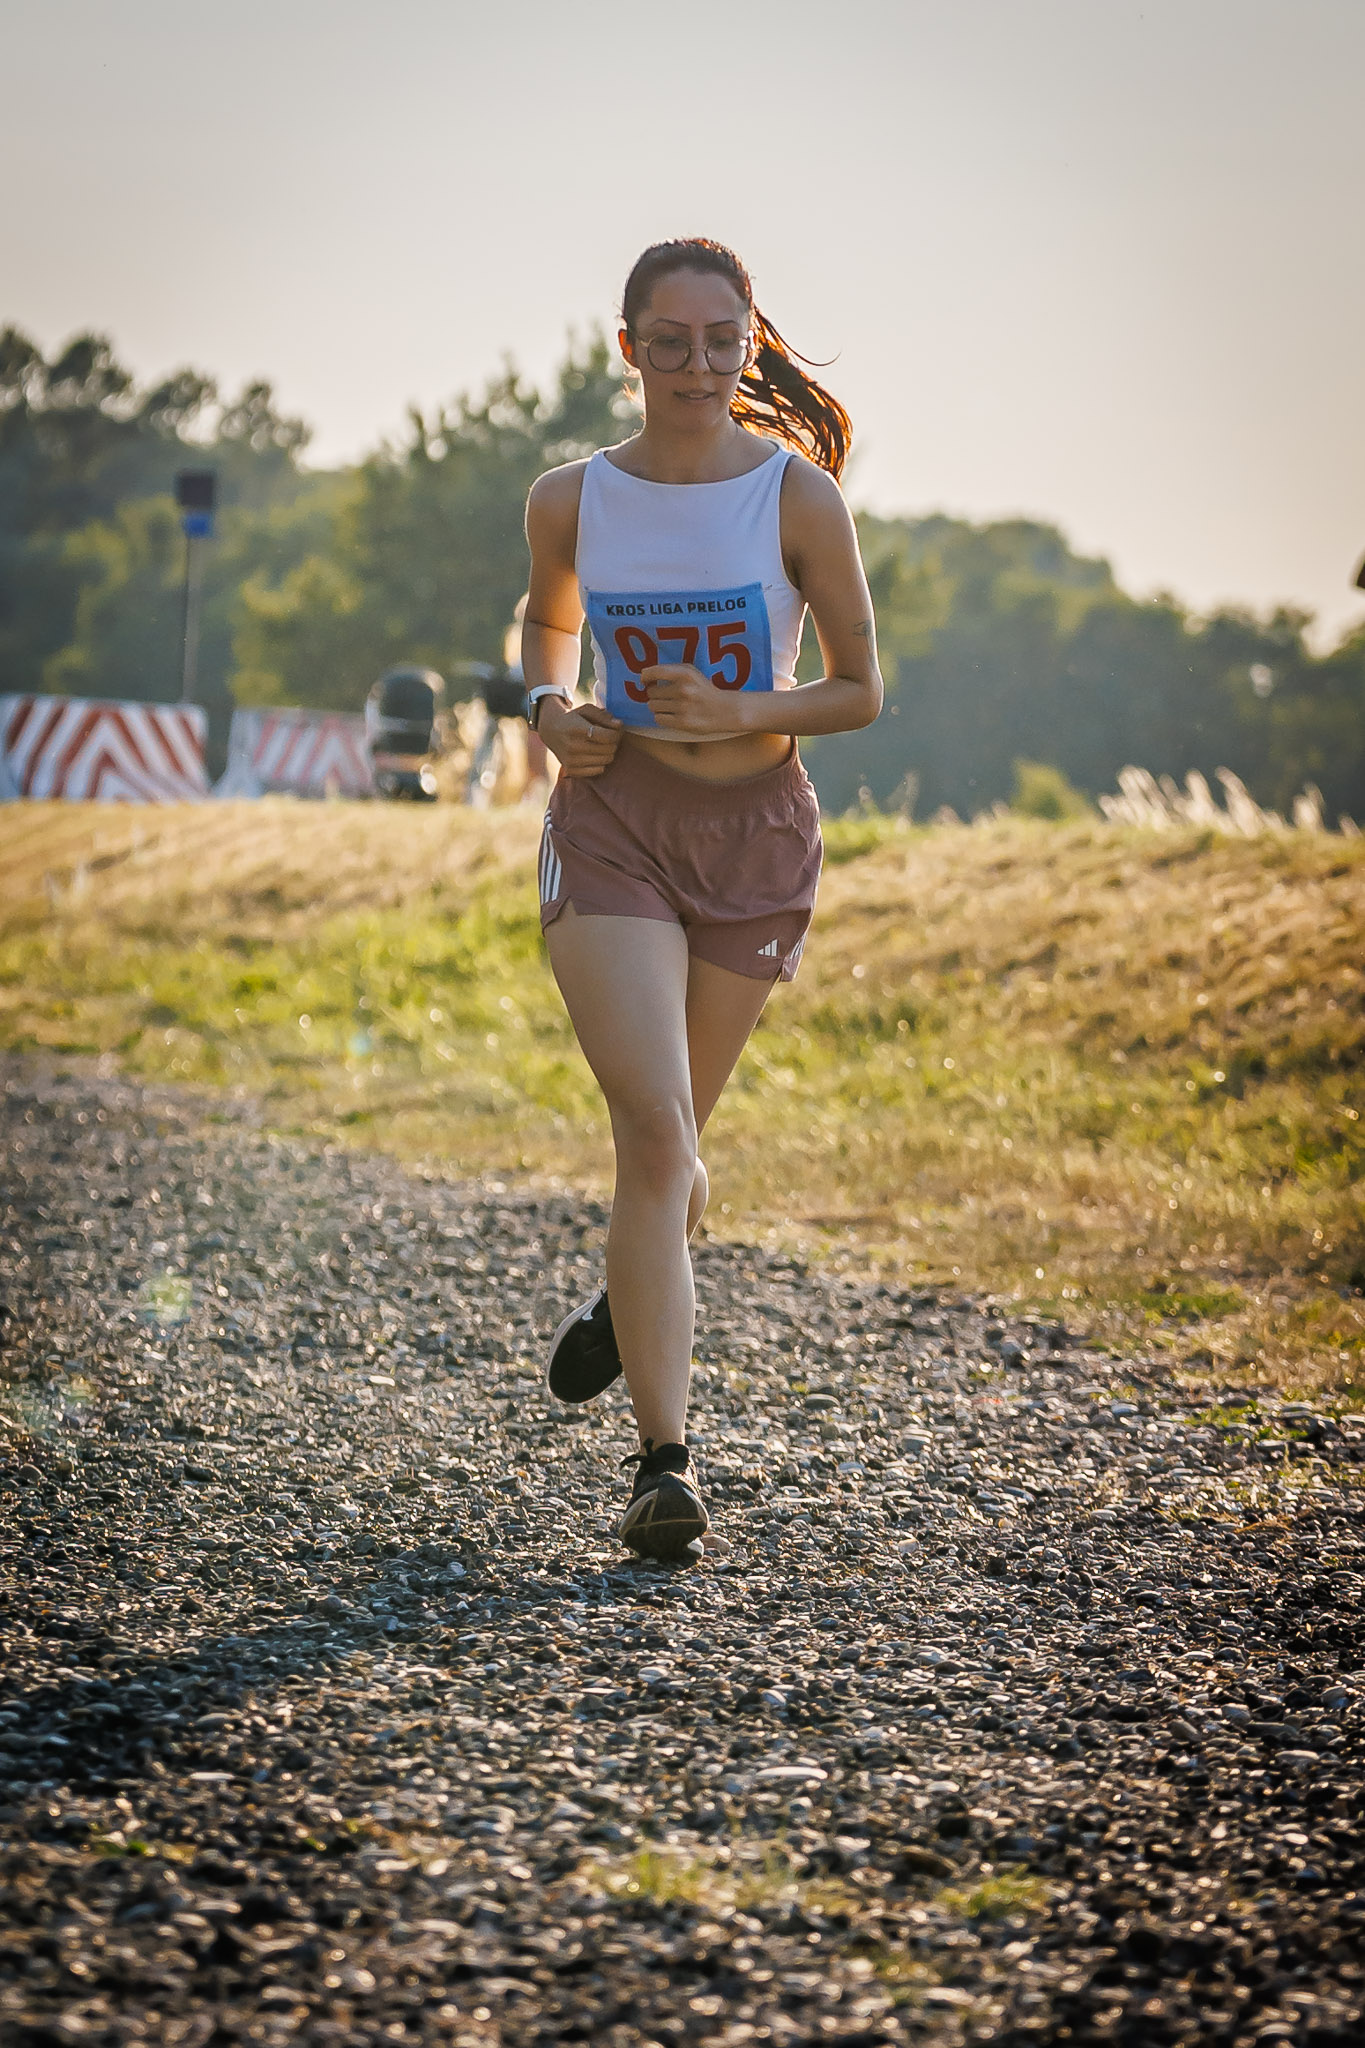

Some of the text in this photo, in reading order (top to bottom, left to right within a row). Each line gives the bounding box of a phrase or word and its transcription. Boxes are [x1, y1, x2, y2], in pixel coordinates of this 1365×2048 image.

[606, 596, 747, 616] KROS LIGA PRELOG
[614, 621, 752, 703] 975
